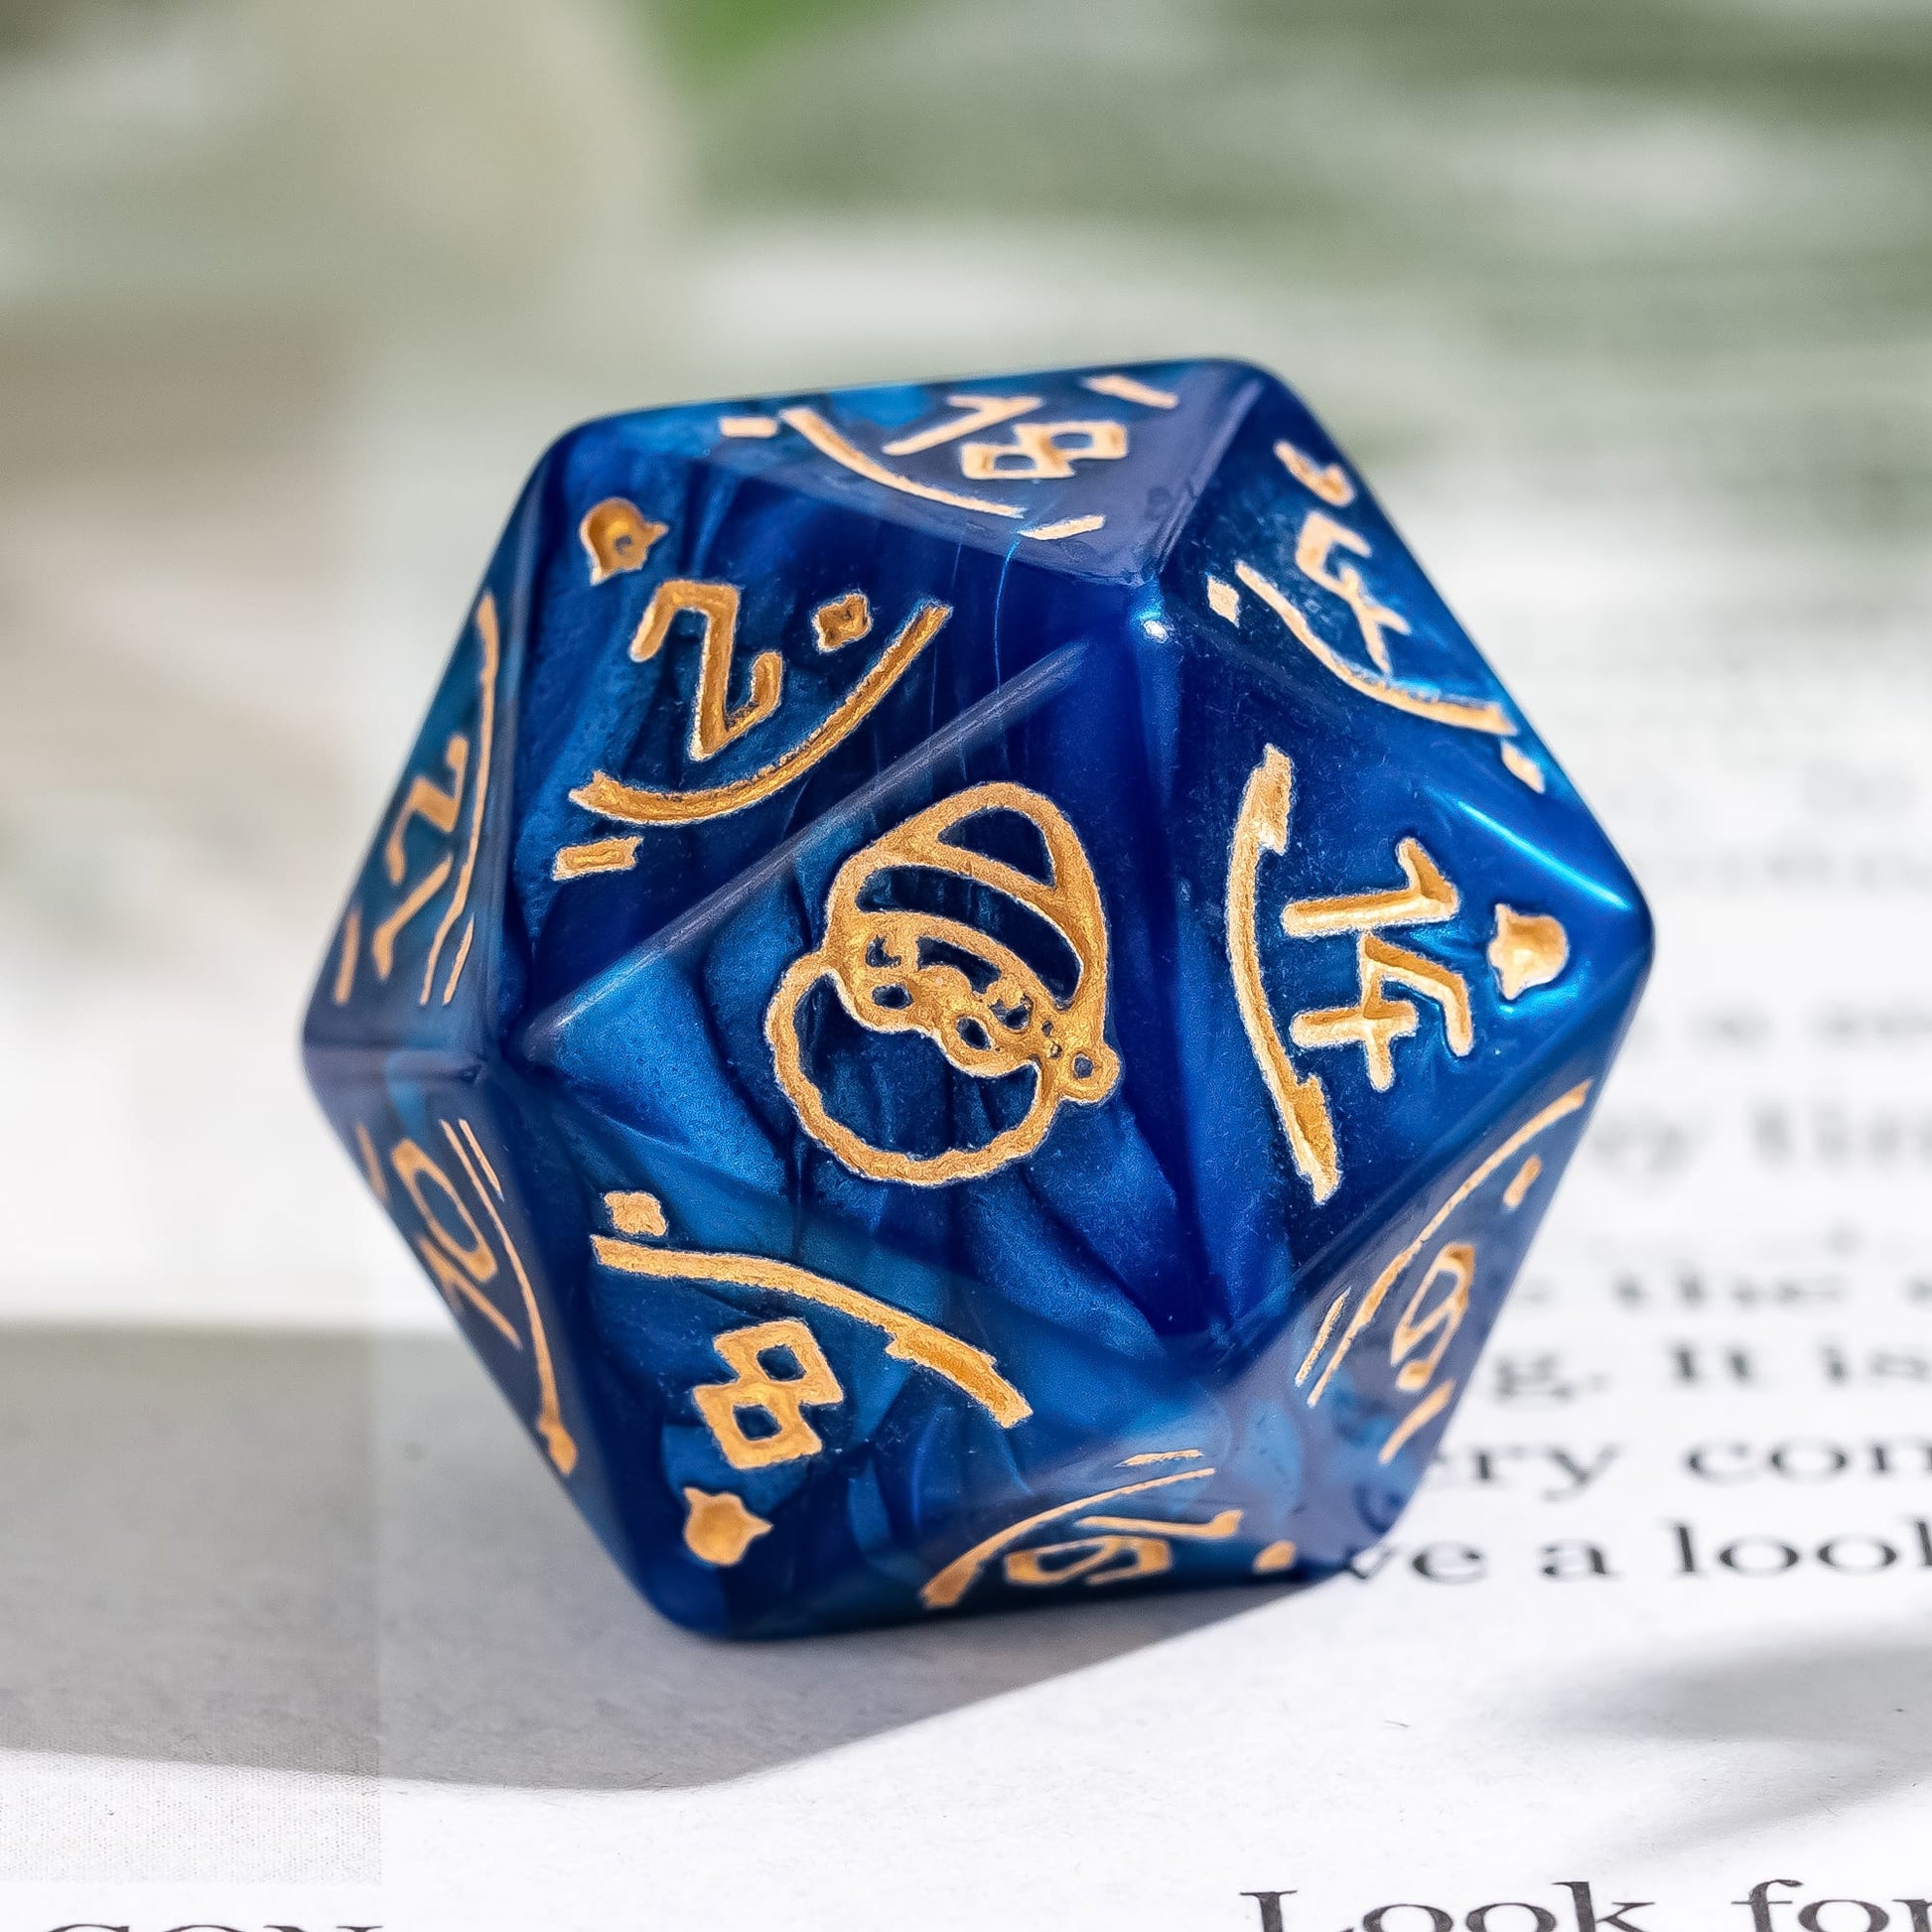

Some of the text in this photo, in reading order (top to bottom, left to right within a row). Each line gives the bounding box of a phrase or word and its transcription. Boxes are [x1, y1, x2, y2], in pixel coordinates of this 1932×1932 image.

[882, 394, 1129, 481] 18
[629, 578, 784, 761] 2
[1294, 511, 1411, 677] 4
[372, 733, 469, 982] 12
[1281, 835, 1474, 1092] 14
[390, 1137, 524, 1351] 10
[691, 1316, 845, 1470] 8
[1436, 1440, 1624, 1503] ry
[1346, 1541, 1485, 1586] ve
[1538, 1540, 1618, 1583] a
